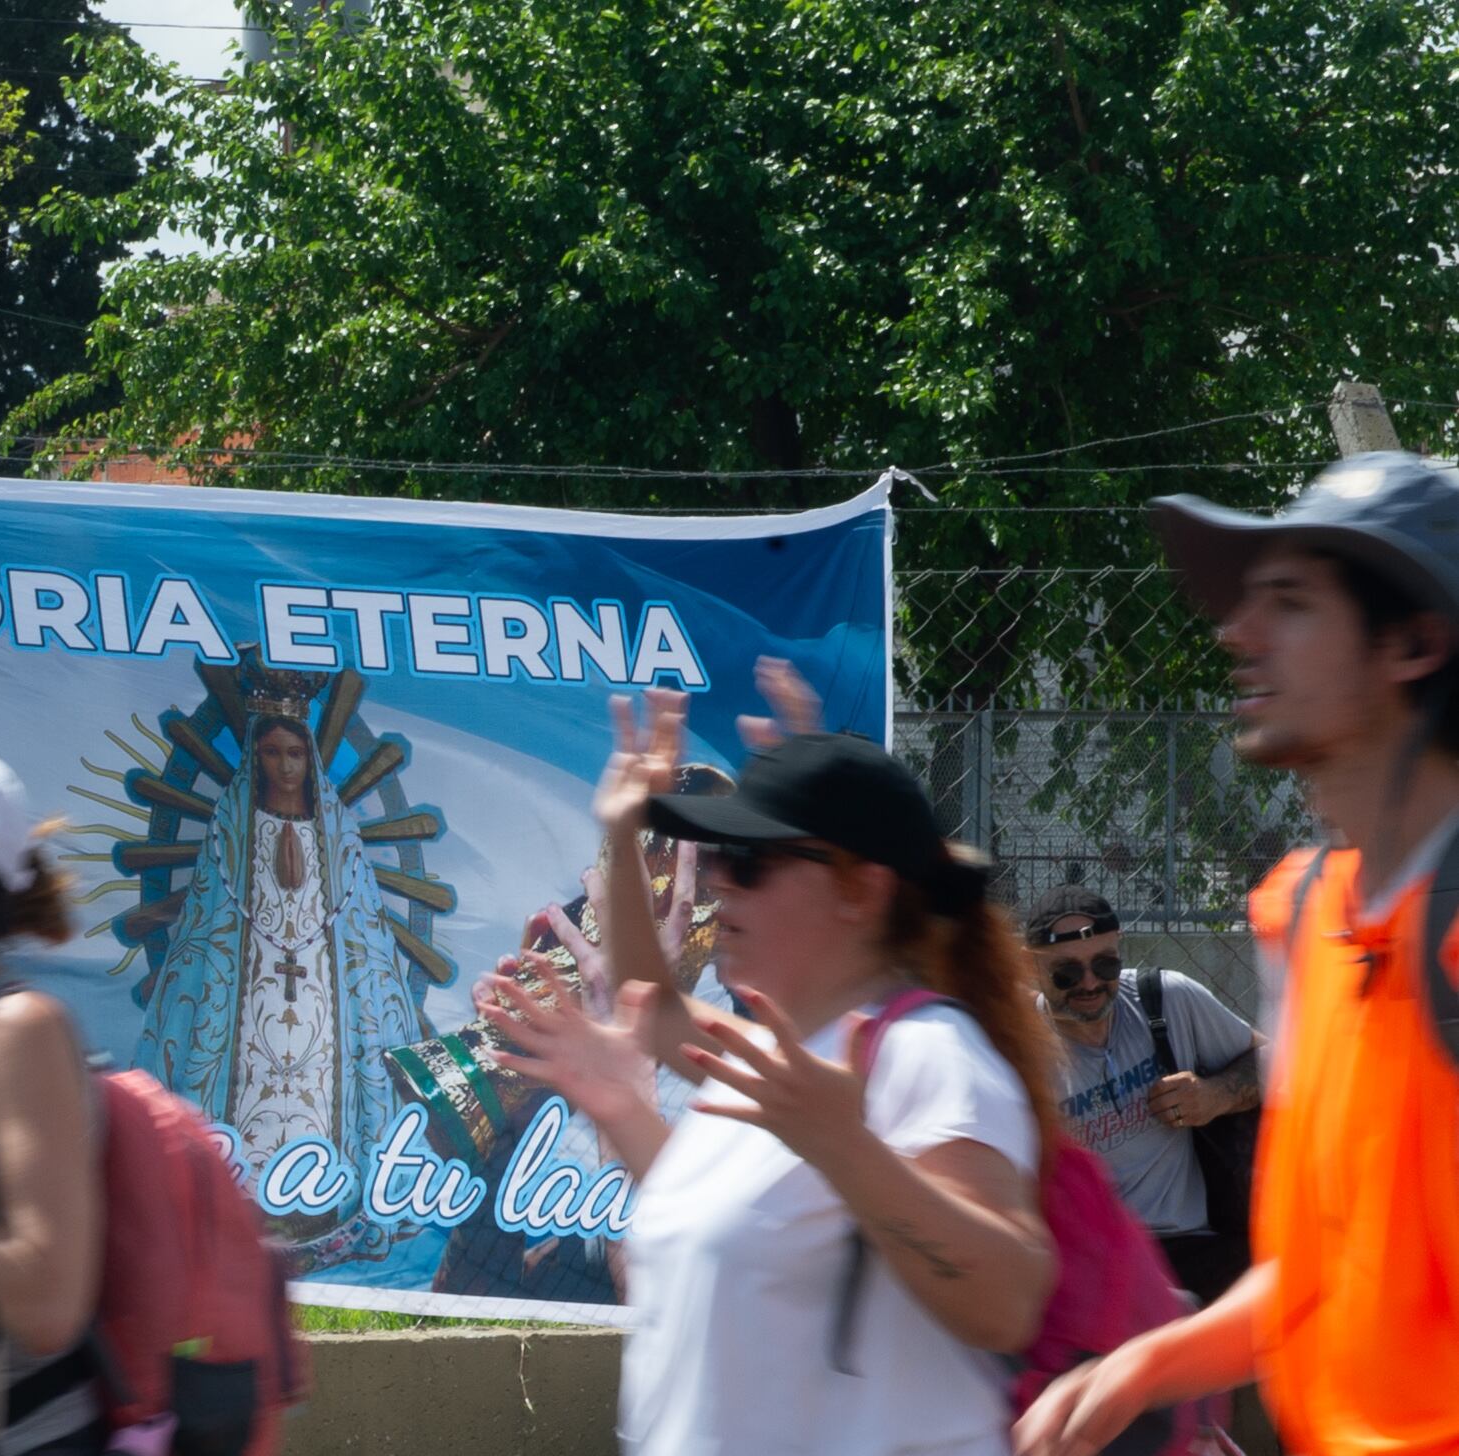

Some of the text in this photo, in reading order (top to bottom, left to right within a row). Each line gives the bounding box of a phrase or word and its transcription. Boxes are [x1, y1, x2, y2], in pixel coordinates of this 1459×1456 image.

[259, 582, 707, 688] ETERNA
[264, 1138, 349, 1211] a
[370, 1107, 481, 1221] tu
